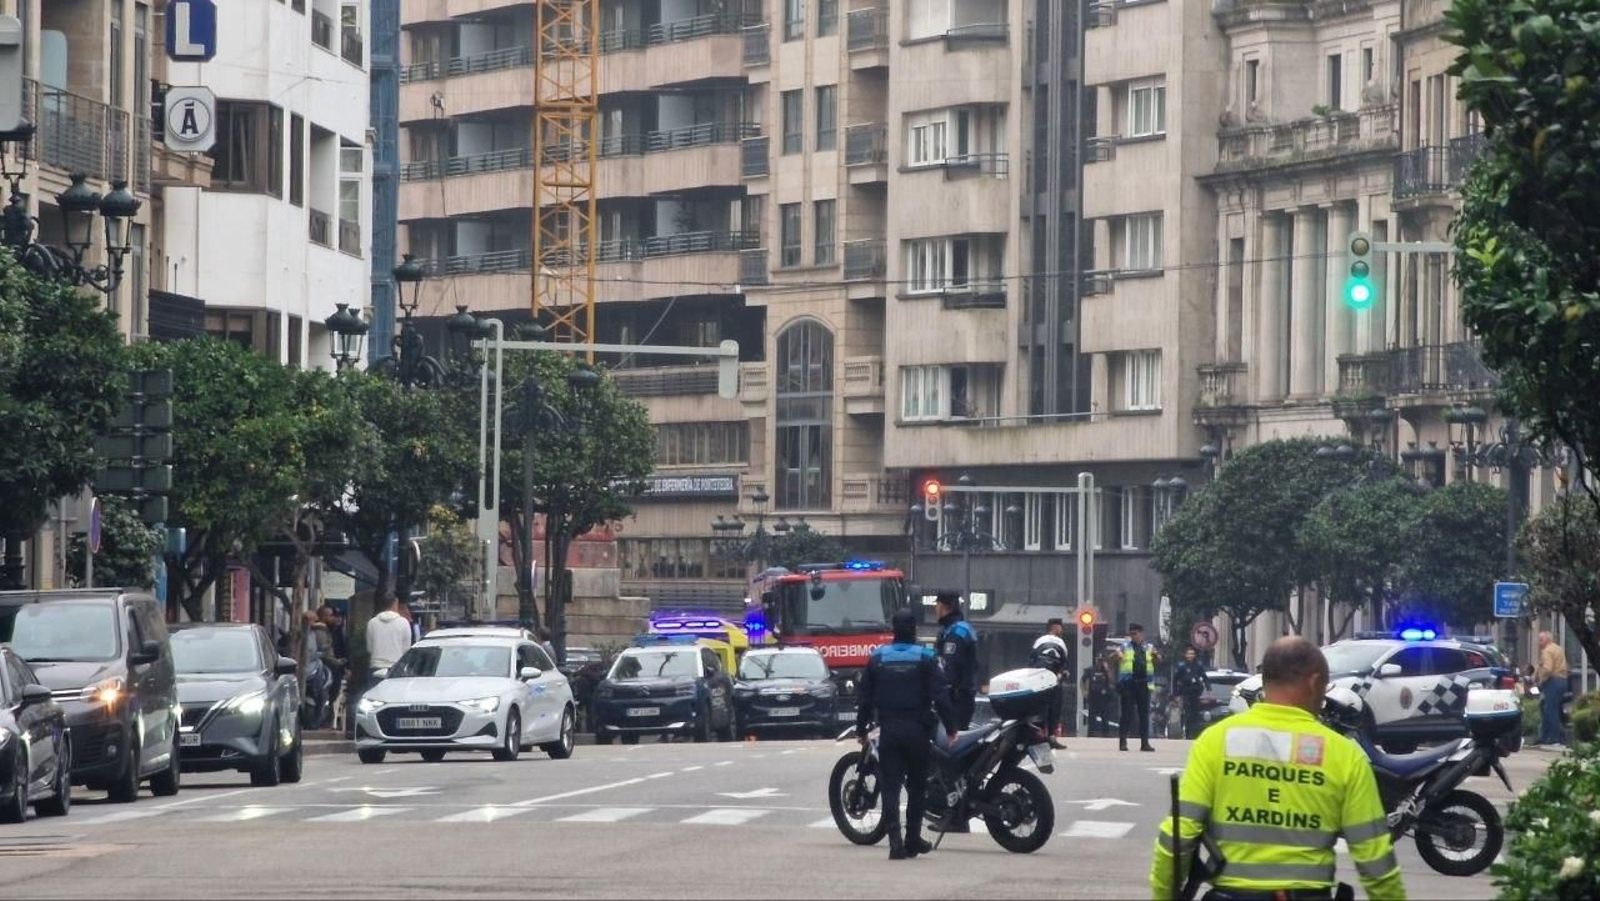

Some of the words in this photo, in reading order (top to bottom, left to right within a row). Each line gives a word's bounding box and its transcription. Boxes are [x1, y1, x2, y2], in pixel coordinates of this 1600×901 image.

[175, 1, 205, 55] L
[1493, 701, 1510, 711] 092
[1223, 761, 1325, 786] PARQUES
[1268, 788, 1281, 804] E
[1226, 806, 1321, 829] XARDÍNS
